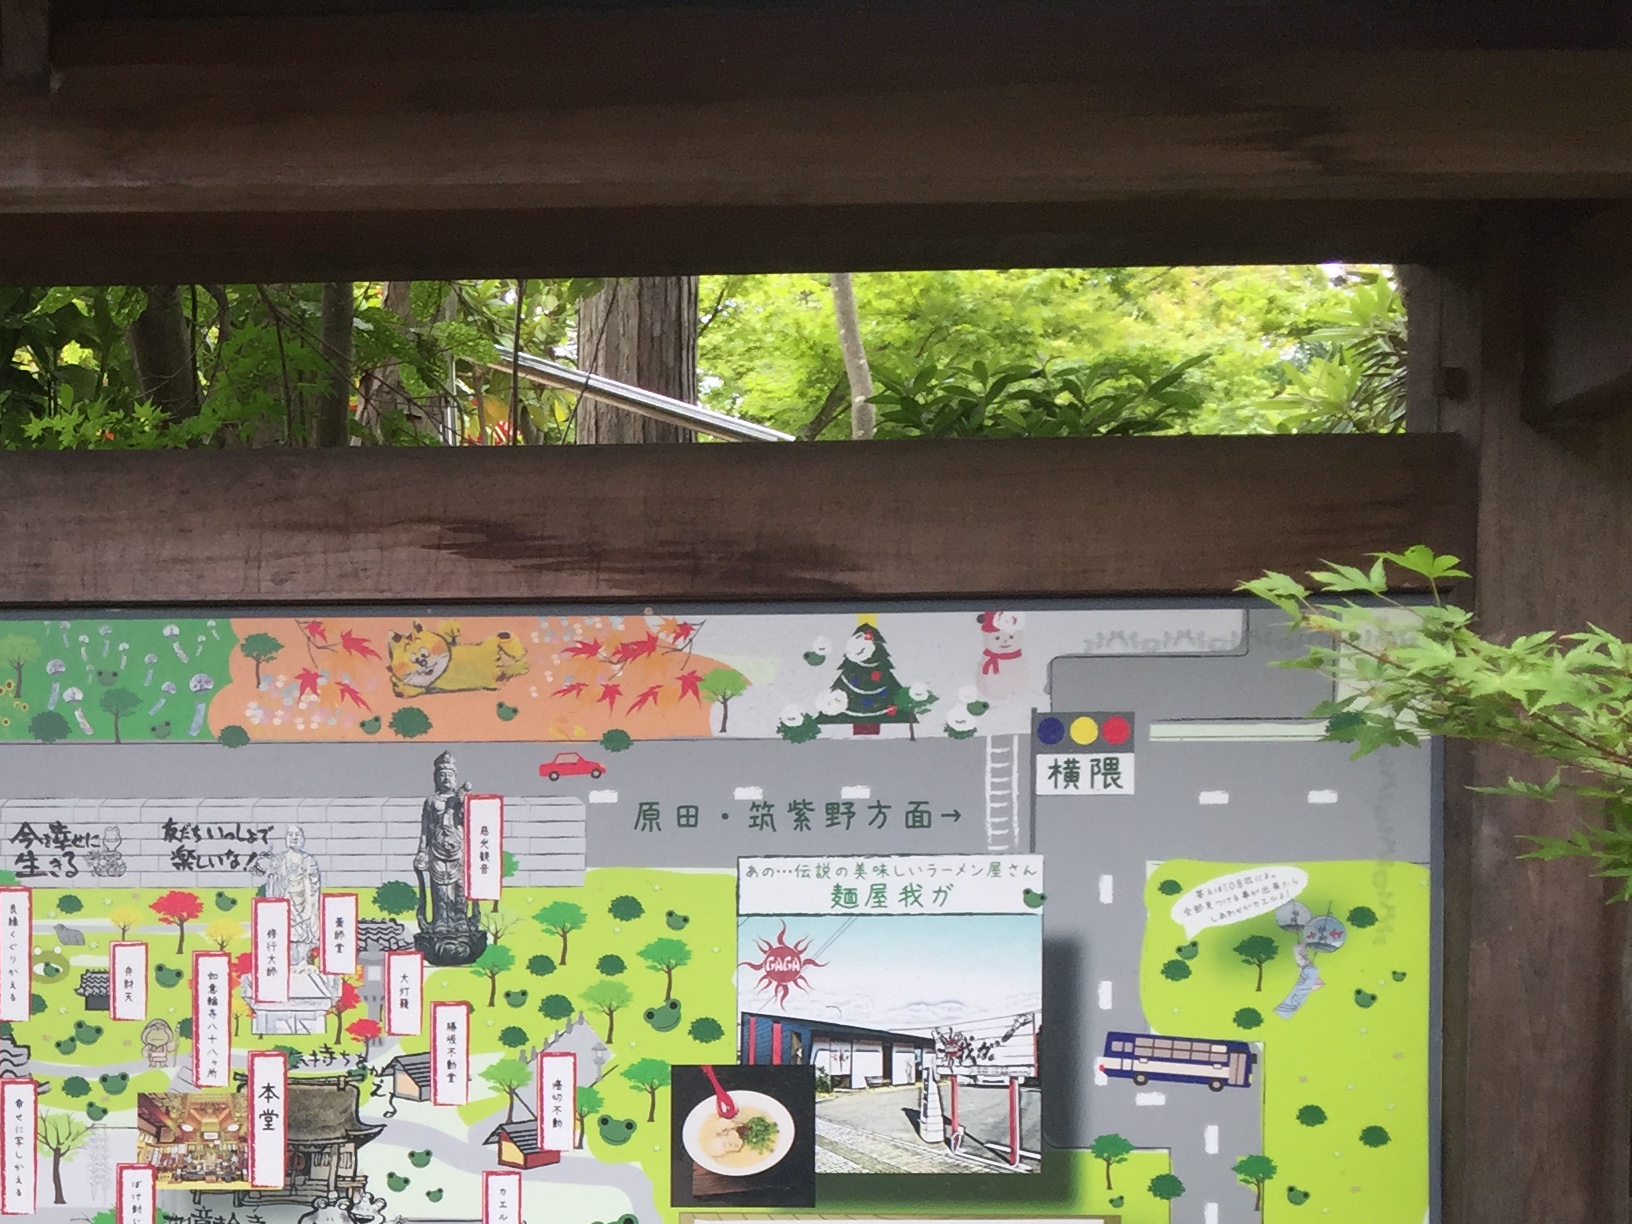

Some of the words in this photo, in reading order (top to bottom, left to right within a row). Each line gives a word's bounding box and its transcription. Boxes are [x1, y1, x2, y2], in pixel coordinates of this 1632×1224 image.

[1047, 756, 1124, 790] 横隈
[633, 798, 932, 833] 原田・筑紫野方面
[14, 850, 80, 880] 生きる
[830, 882, 955, 910] 麺屋我ガ
[764, 953, 802, 975] GAGA
[257, 1082, 280, 1131] 本堂
